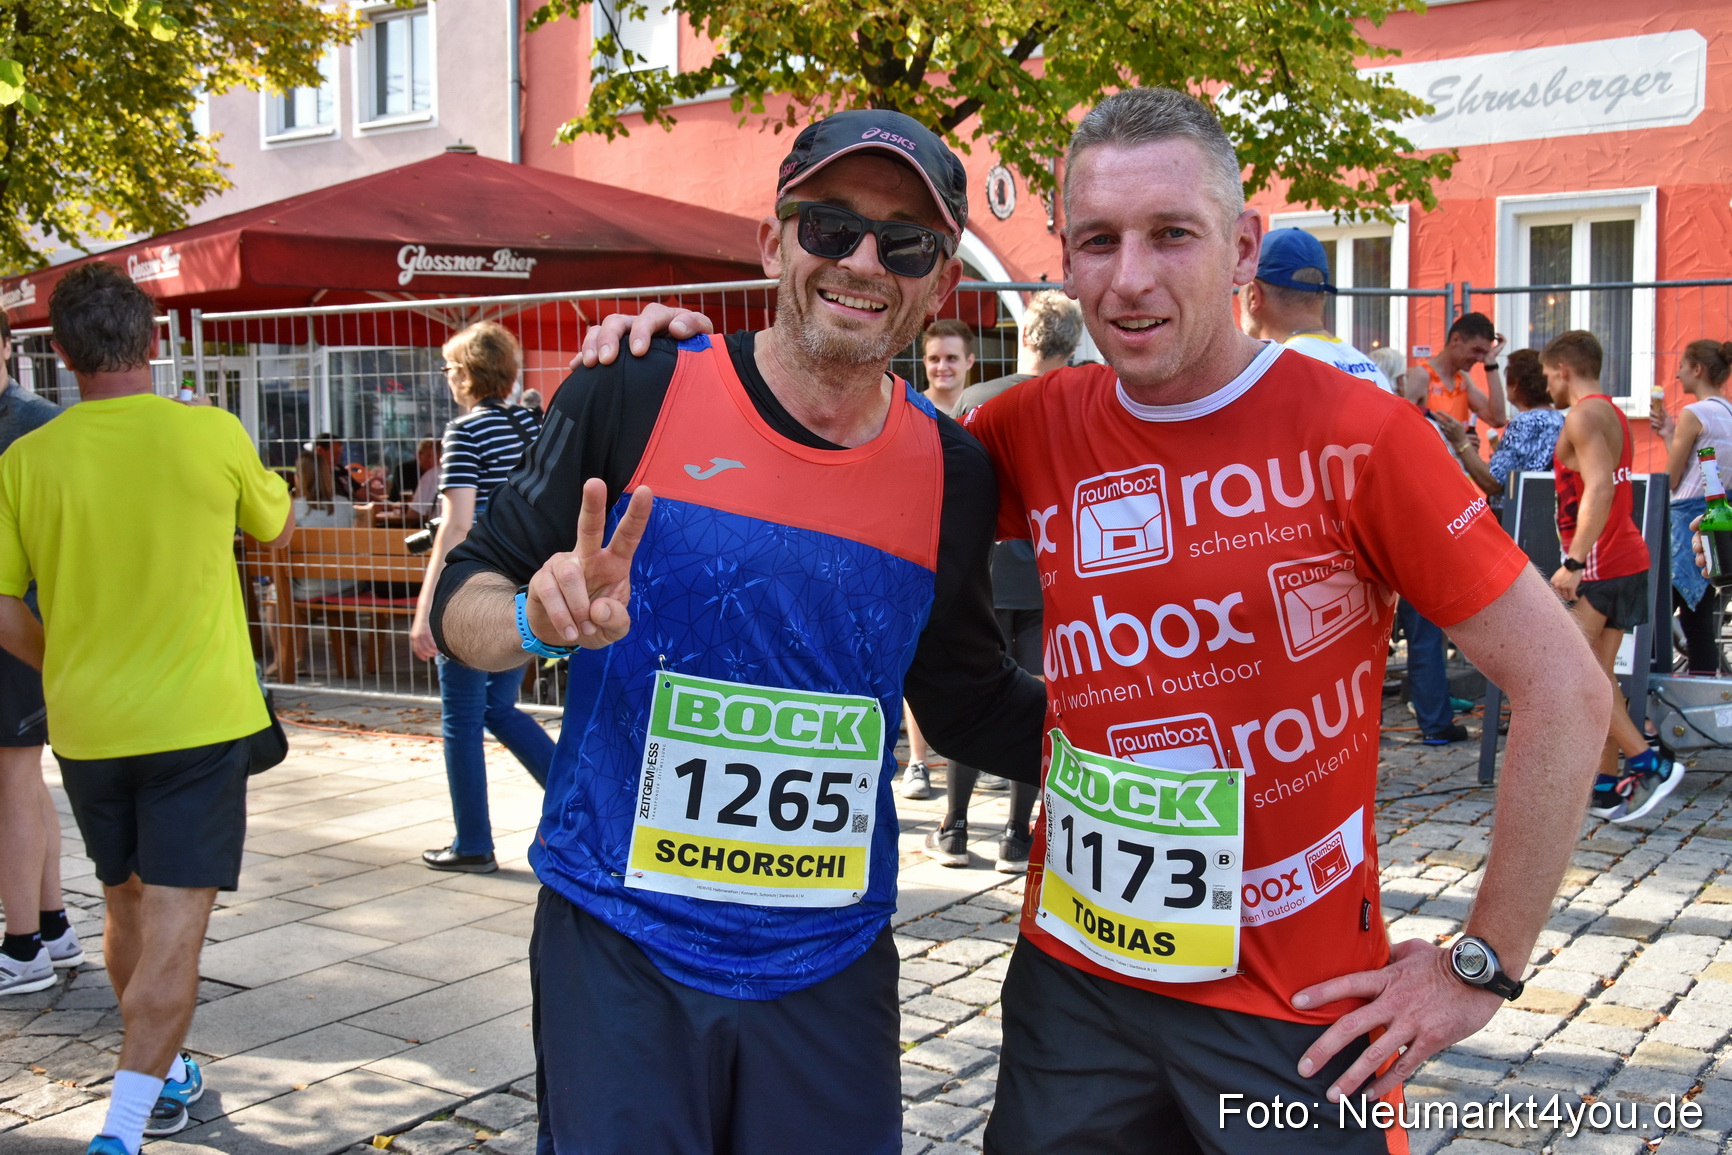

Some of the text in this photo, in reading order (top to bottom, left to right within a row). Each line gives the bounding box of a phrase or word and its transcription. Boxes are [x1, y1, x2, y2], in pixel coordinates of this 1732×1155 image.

[1422, 66, 1673, 123] Ehrnsberger
[880, 130, 917, 151] asics
[397, 244, 537, 286] Glossner-Bier
[1080, 474, 1158, 505] raumbox
[1446, 497, 1487, 535] raumbo
[1189, 522, 1312, 558] schenken
[1067, 683, 1142, 711] wohnen
[1161, 659, 1263, 694] outdoor
[671, 688, 865, 749] BOCK
[1115, 725, 1209, 753] raumbox
[675, 758, 853, 833] 1265
[858, 777, 868, 789] A
[1057, 747, 1214, 825] BOCK
[1254, 747, 1350, 808] schenken
[655, 839, 846, 878] SCHORSCHI
[1061, 814, 1207, 909] 1173
[1218, 854, 1230, 865] B
[1308, 836, 1342, 864] raumbox
[1267, 895, 1306, 918] outdoor
[1072, 896, 1176, 957] TOBIAS
